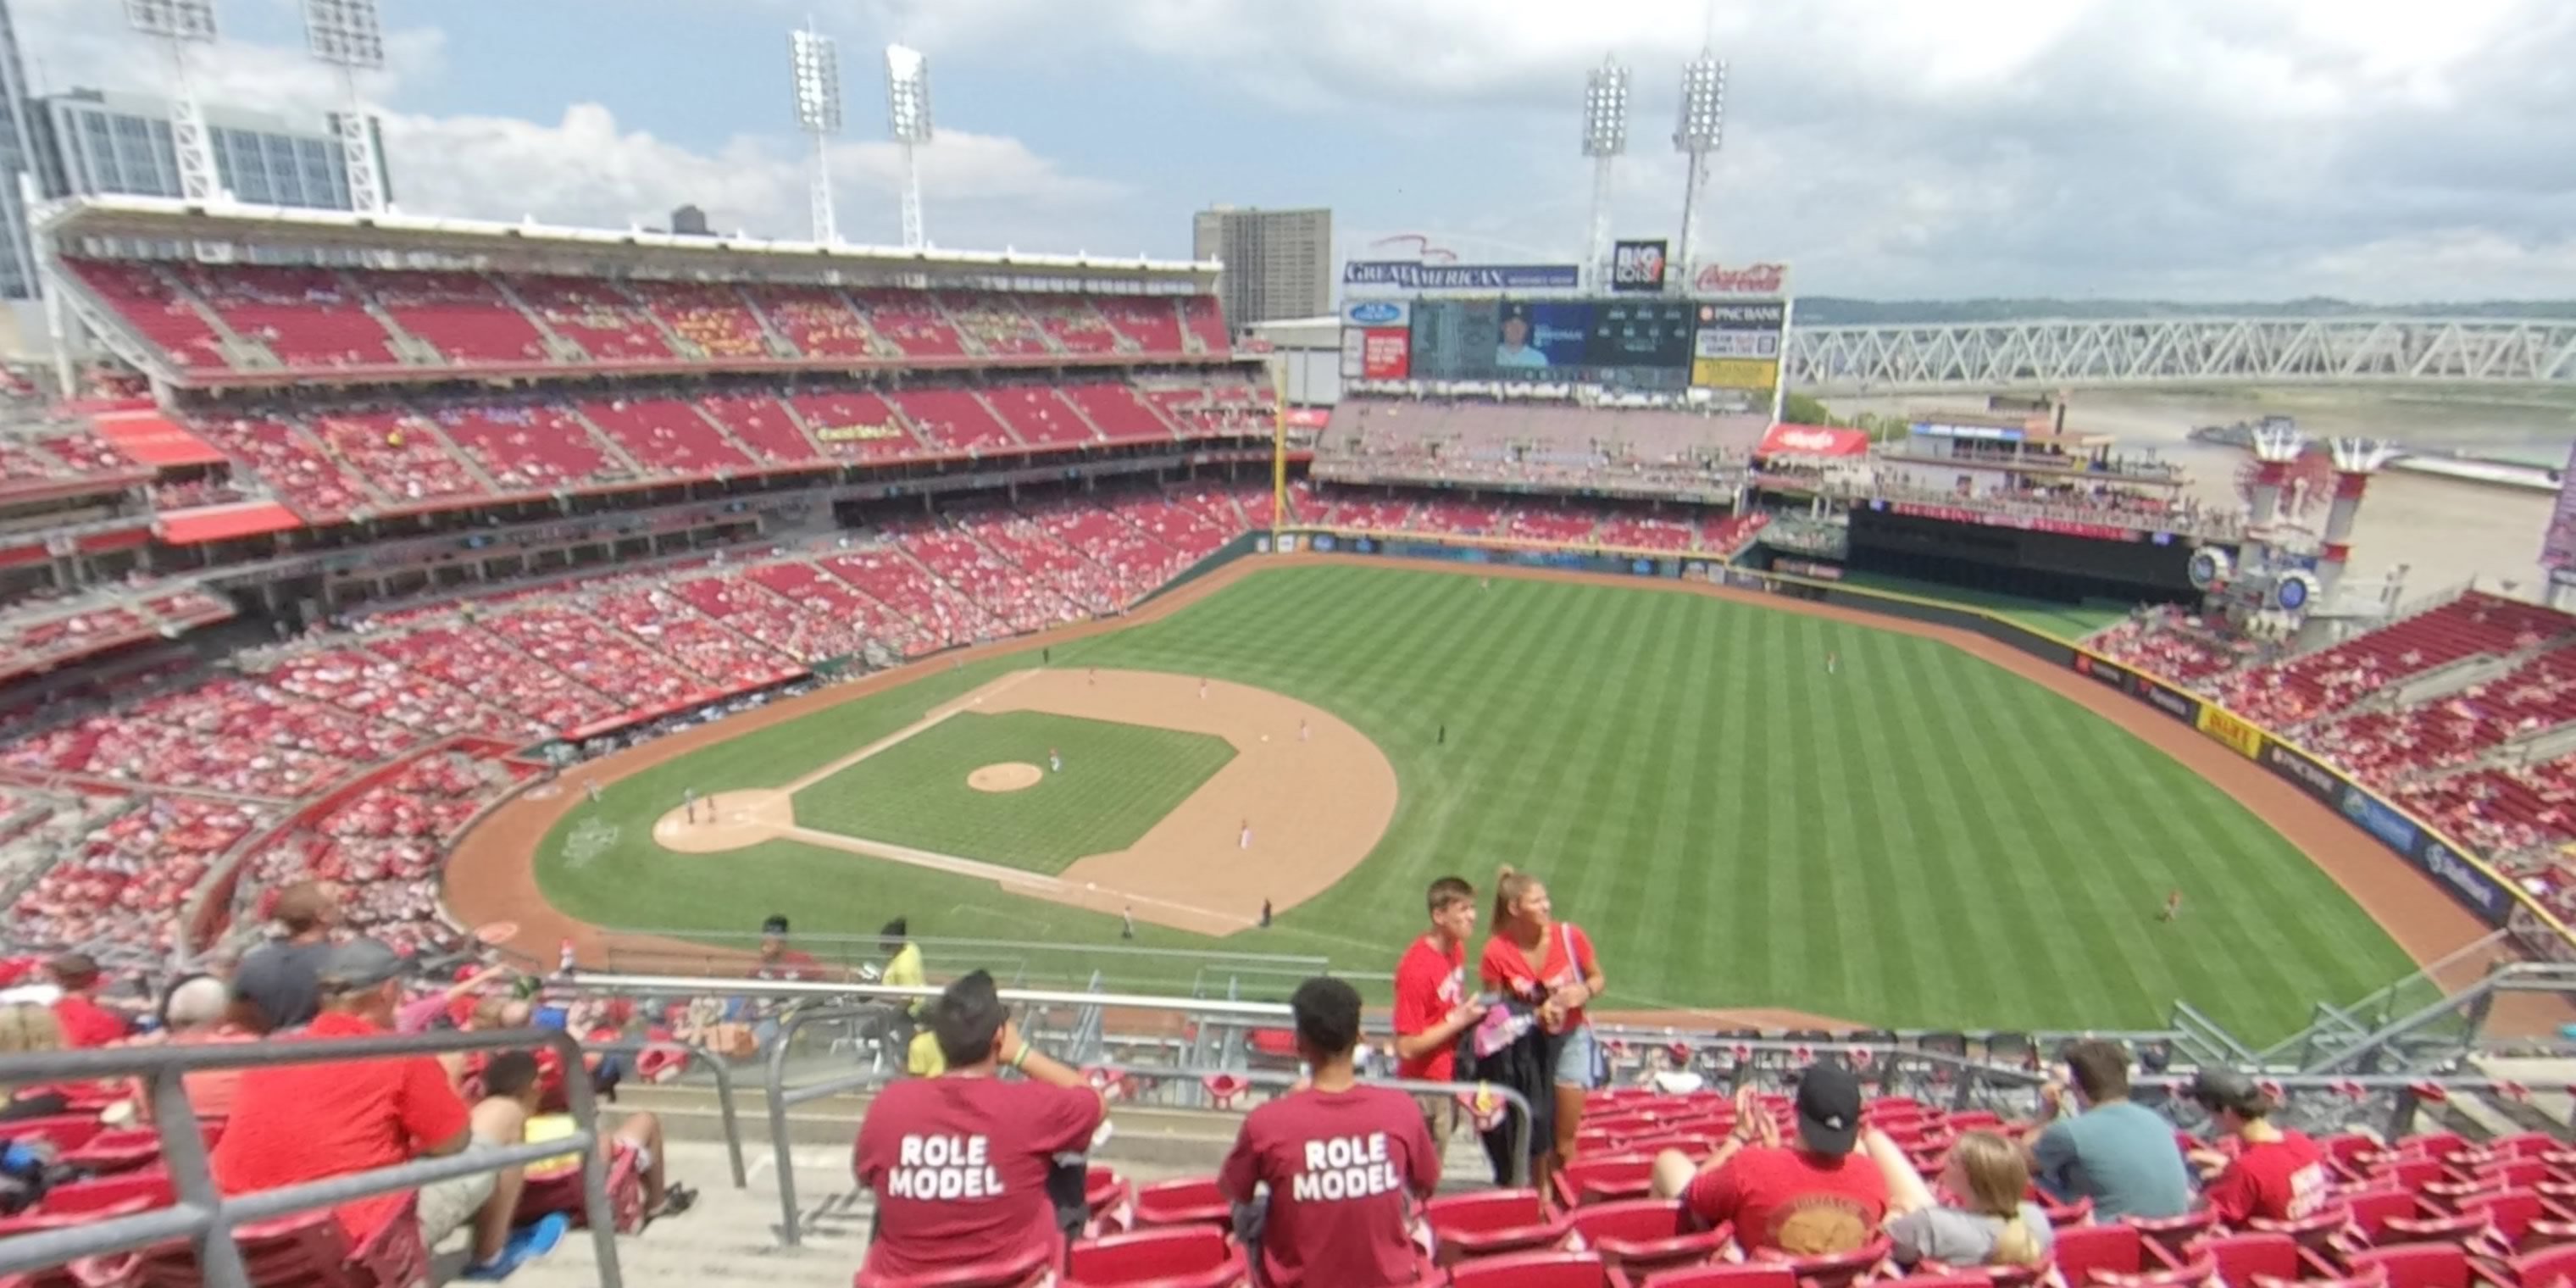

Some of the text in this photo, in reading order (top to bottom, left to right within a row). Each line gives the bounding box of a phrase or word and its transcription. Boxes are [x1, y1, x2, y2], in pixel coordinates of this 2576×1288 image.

[1347, 263, 1407, 281] GREAT
[1407, 264, 1505, 286] AMERICAN
[1696, 263, 1787, 291] Coca-Cola
[1715, 307, 1781, 321] PNC BANK
[900, 1134, 988, 1168] ROLE
[1305, 1131, 1386, 1171] ROLE
[888, 1164, 1006, 1200] MODEL
[1292, 1160, 1400, 1202] MODEL
